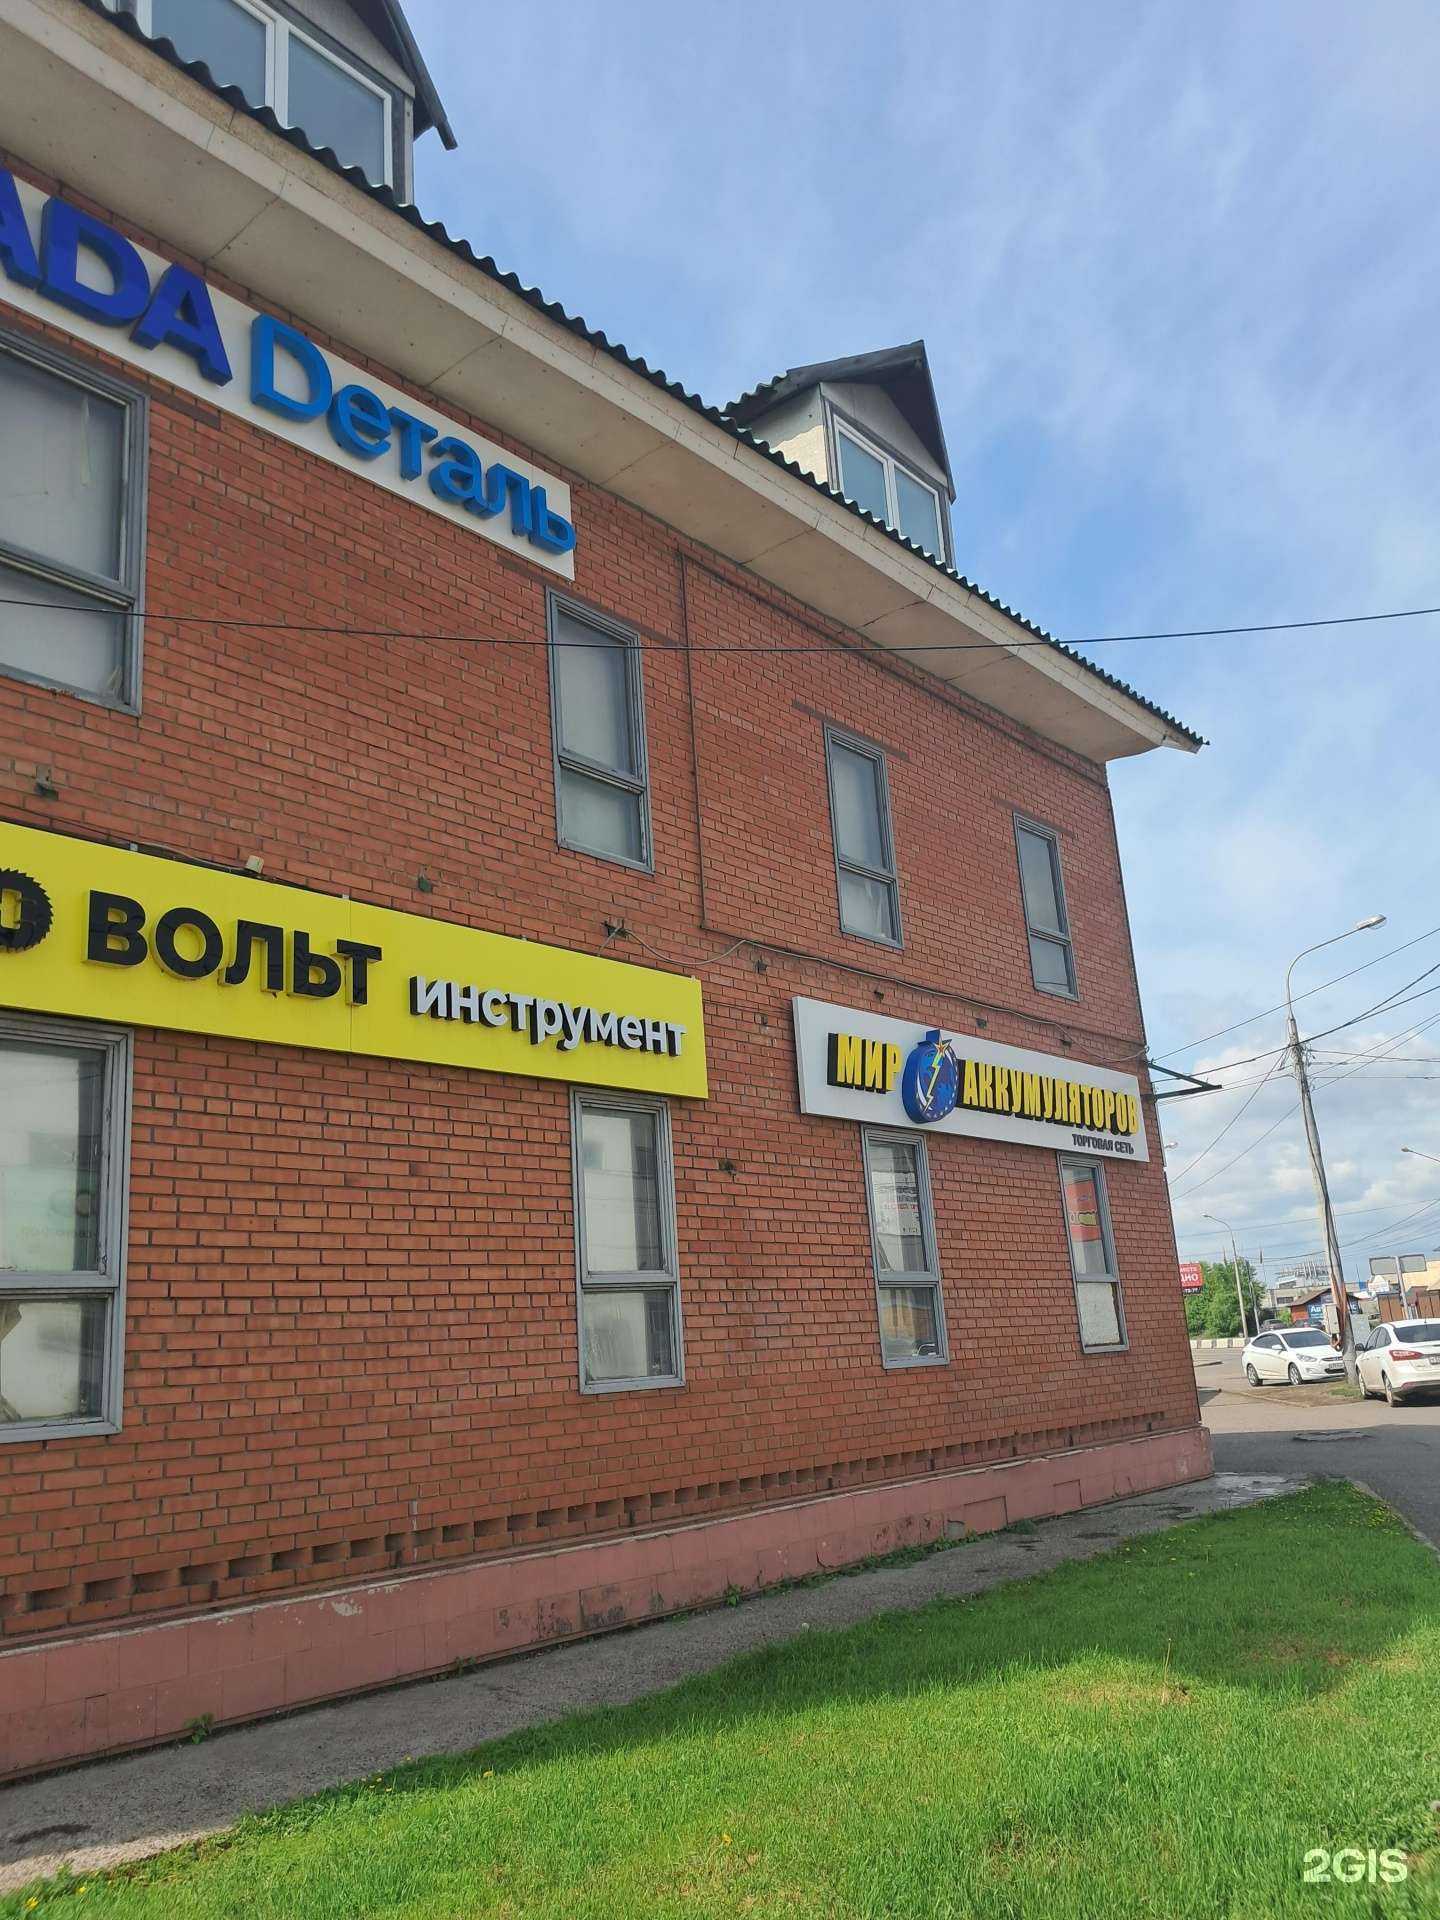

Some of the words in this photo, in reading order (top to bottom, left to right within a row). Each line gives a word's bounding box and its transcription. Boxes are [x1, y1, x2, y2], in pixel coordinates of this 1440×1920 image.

[409, 975, 687, 1057] инструмент
[828, 1032, 902, 1094] МИР
[957, 1059, 1140, 1137] АККУМУЛЯТОРОВ
[1072, 1133, 1113, 1152] ТОРГОВАЯ
[1114, 1140, 1135, 1155] СЕТЬ
